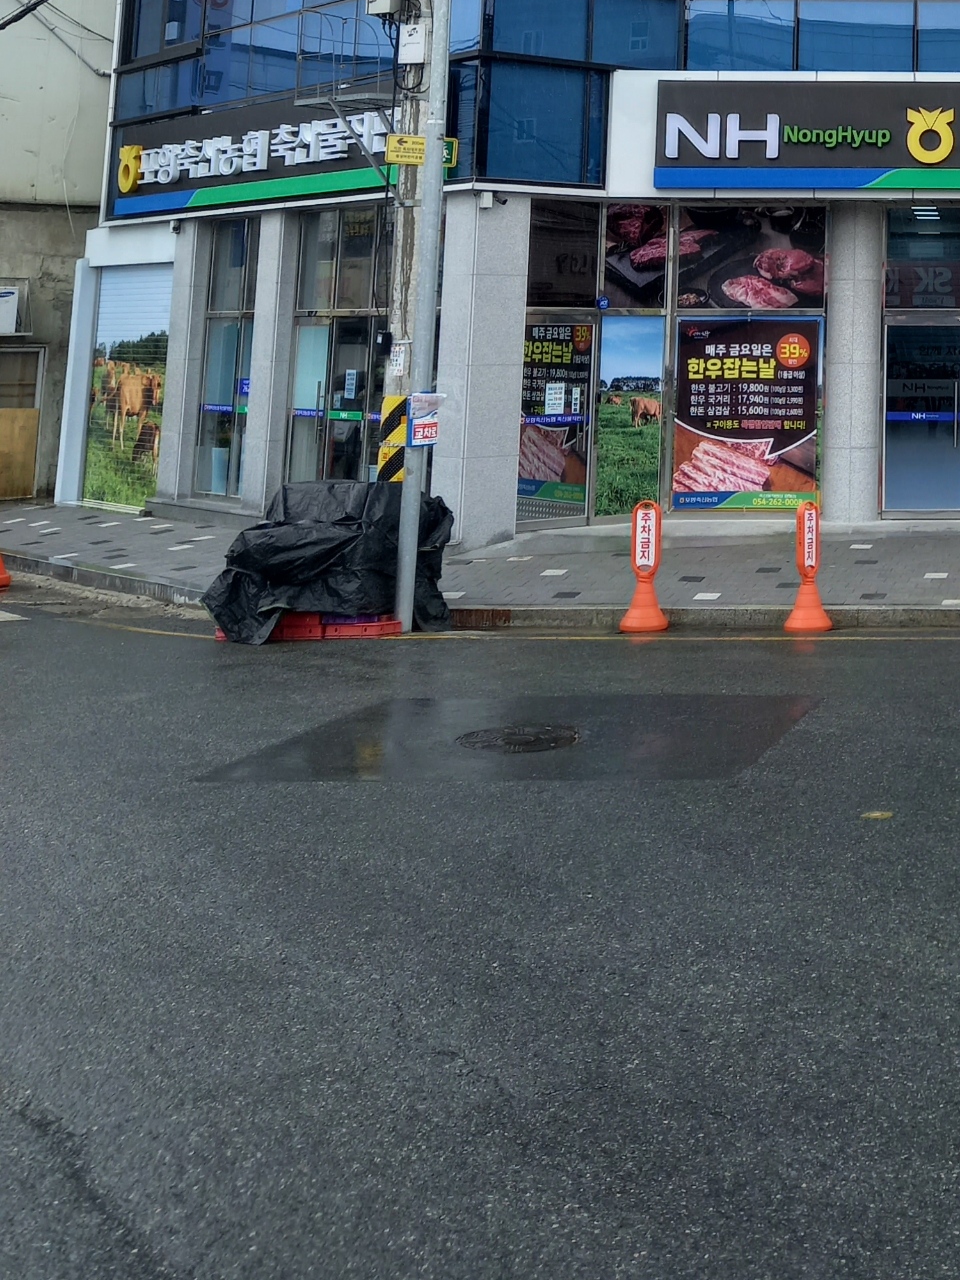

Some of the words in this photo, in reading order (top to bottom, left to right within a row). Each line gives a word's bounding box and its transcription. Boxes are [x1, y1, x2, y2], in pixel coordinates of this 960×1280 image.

[665, 113, 780, 159] NH
[783, 125, 891, 148] NongHyup
[137, 130, 270, 184] 포항축산농협
[705, 344, 726, 357] 매주
[729, 344, 773, 357] 금요일은
[780, 343, 808, 358] 39%
[687, 357, 776, 380] 한우잡는날
[691, 383, 706, 394] 한우
[708, 383, 731, 394] 불고기
[690, 395, 705, 405] 한우
[708, 395, 731, 405] 국거리
[690, 406, 705, 416] 한돈
[707, 406, 730, 416] 삼겹살
[414, 425, 437, 440] 교차로
[640, 512, 651, 562] 주차금지
[806, 512, 814, 562] 주차금지
